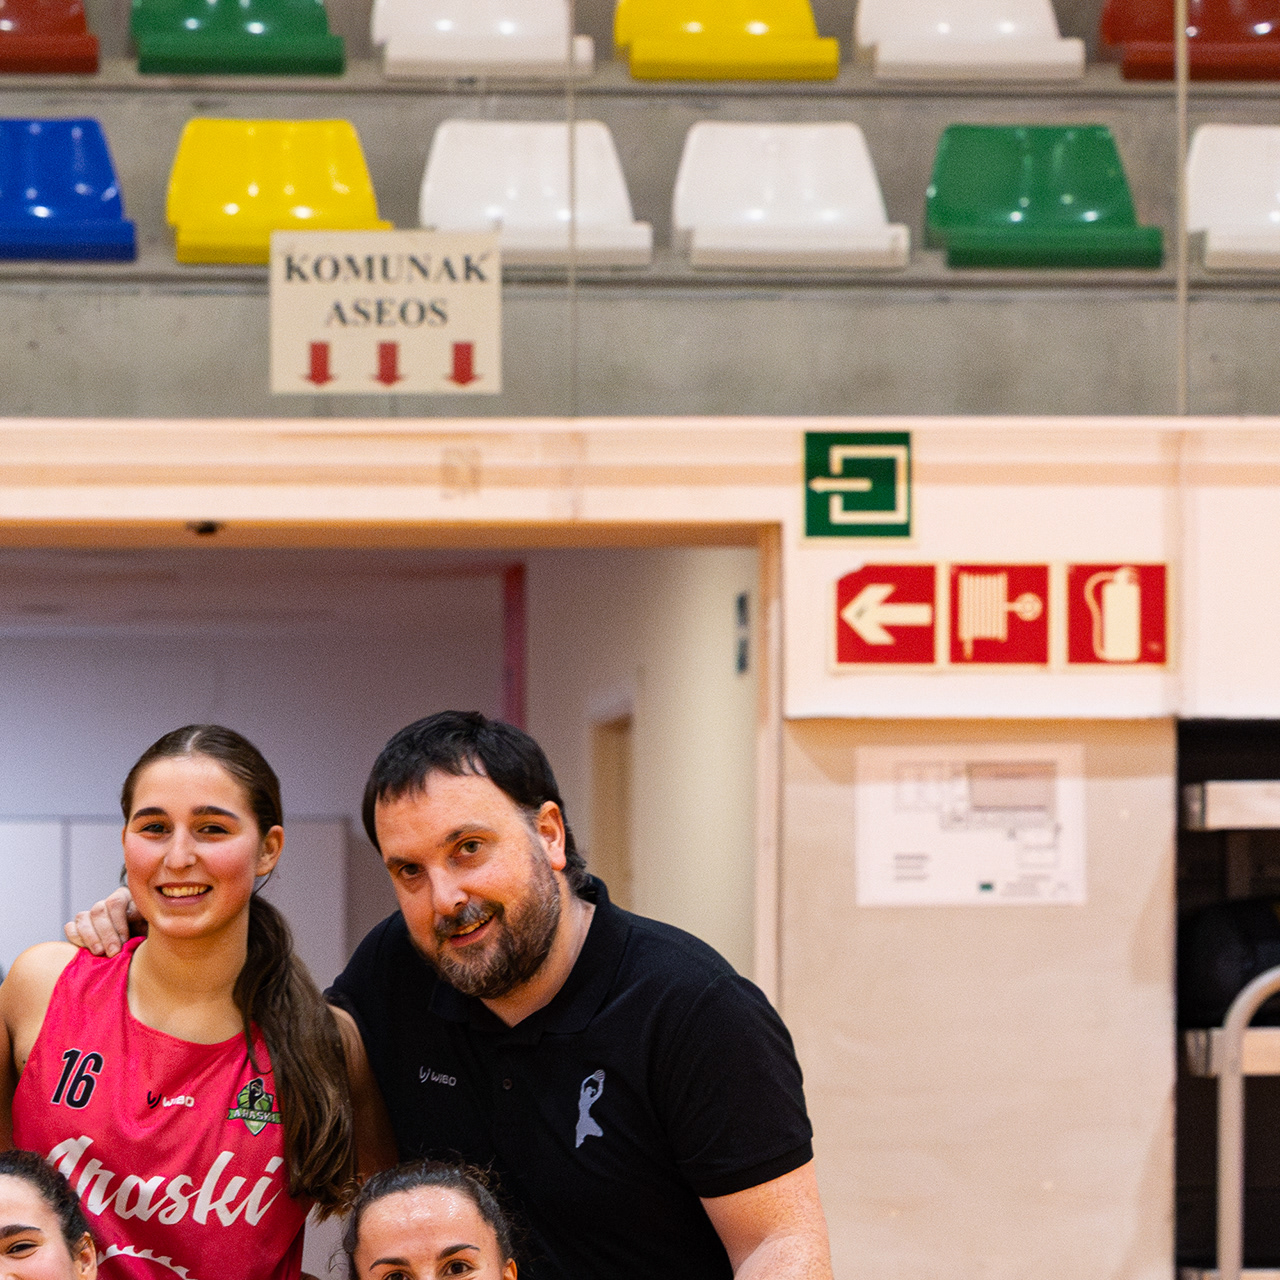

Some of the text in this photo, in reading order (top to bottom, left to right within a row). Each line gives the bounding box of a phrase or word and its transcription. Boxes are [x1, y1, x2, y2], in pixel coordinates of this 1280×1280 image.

[284, 253, 490, 283] KOMUNAK
[326, 299, 449, 328] ASEOS
[50, 1048, 104, 1109] 16
[162, 1094, 195, 1108] WIBO
